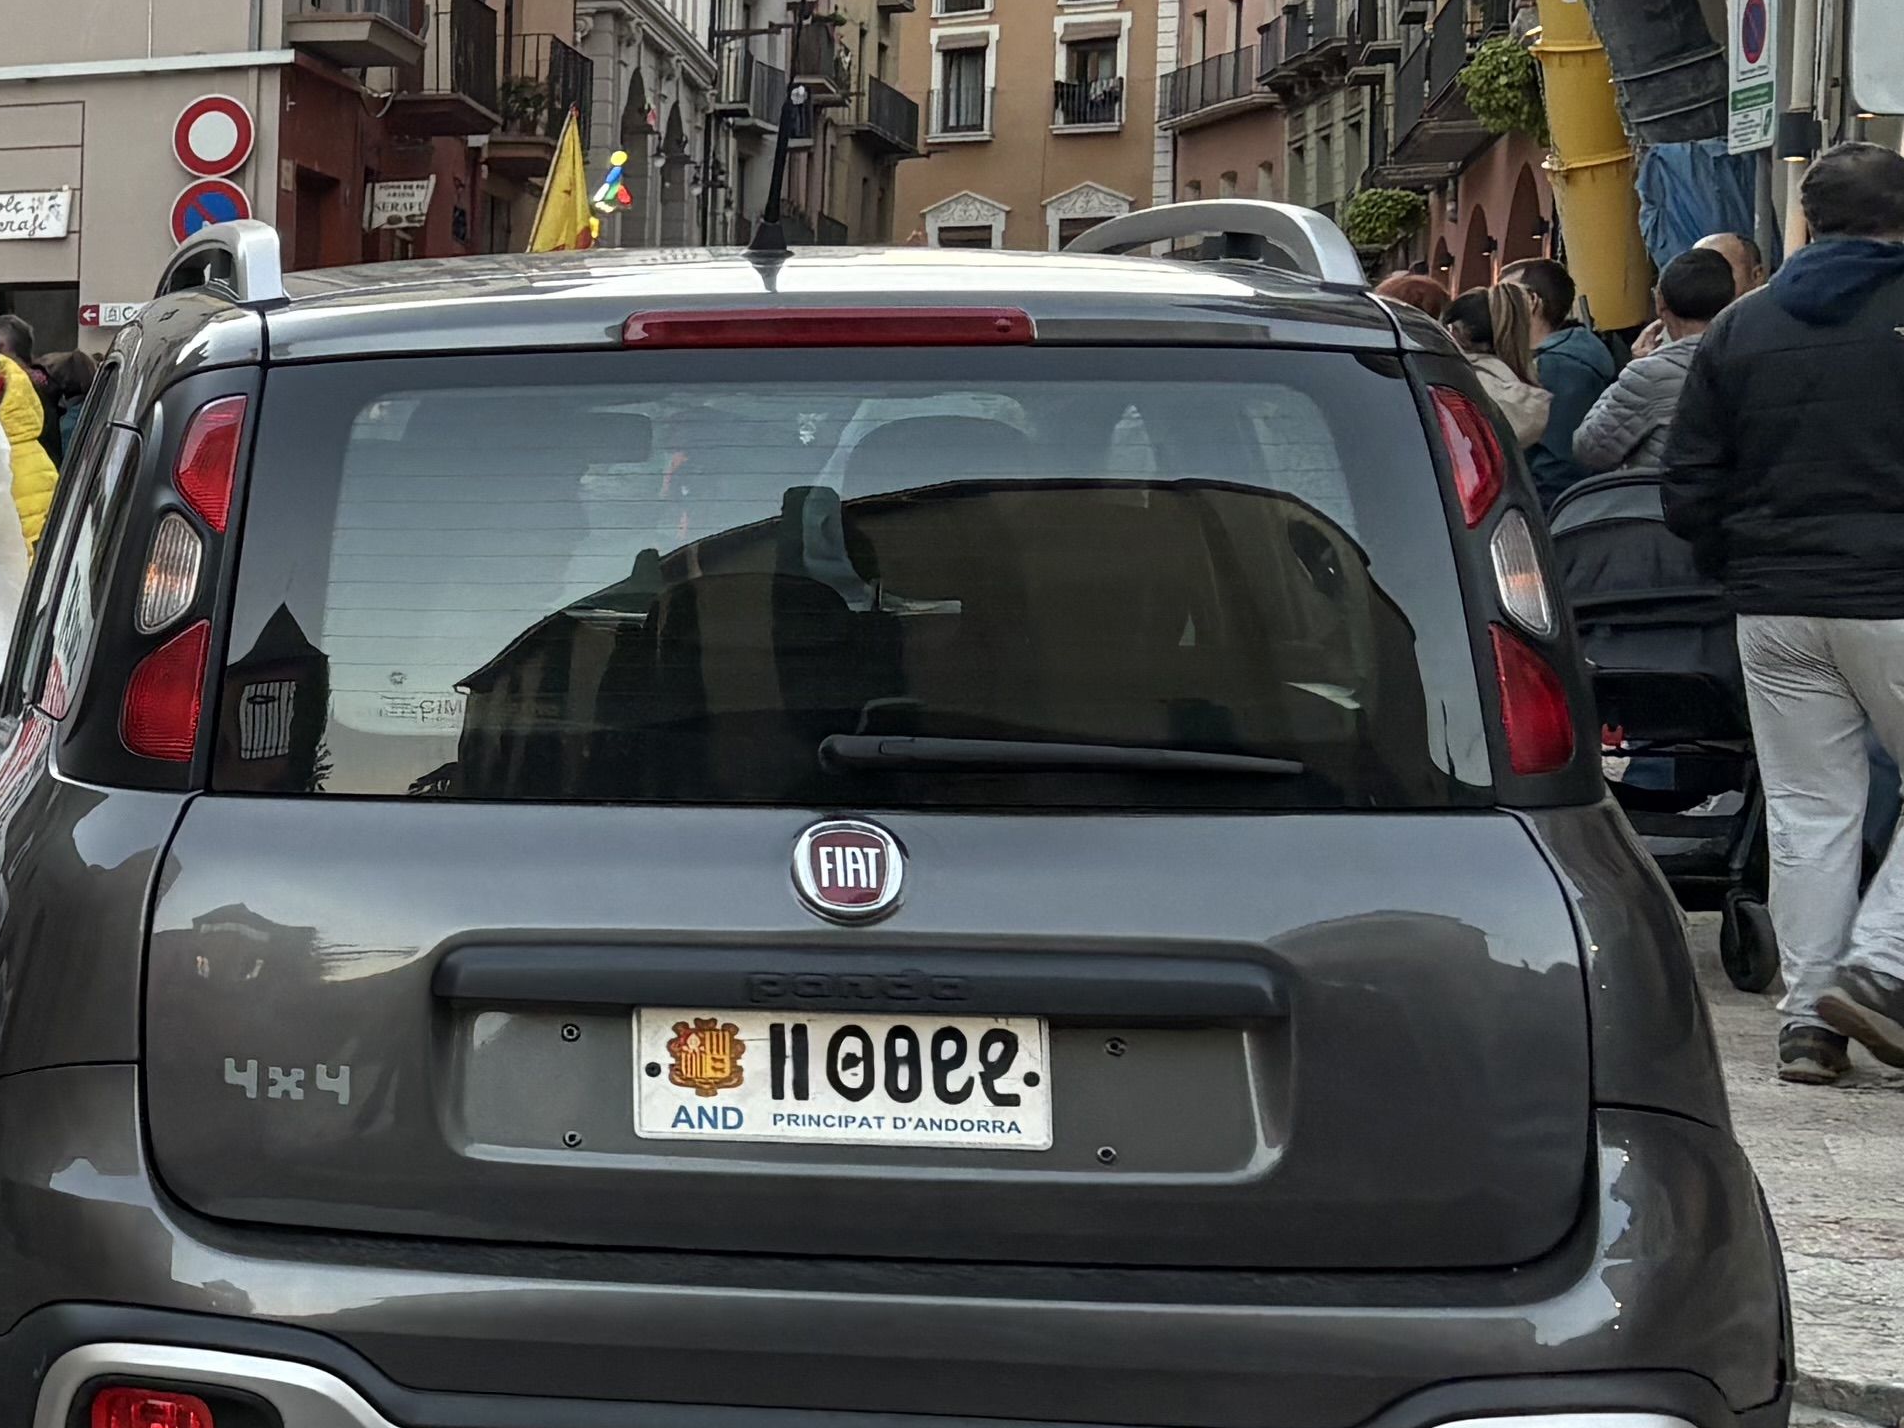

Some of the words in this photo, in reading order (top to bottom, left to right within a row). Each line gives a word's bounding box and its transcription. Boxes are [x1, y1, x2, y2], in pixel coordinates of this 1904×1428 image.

[819, 846, 881, 889] FIAT
[224, 1058, 351, 1105] 4x4
[671, 1105, 744, 1131] AND
[772, 1113, 886, 1130] PRINCIPAT
[892, 1116, 1022, 1135] D'ANDORRA
